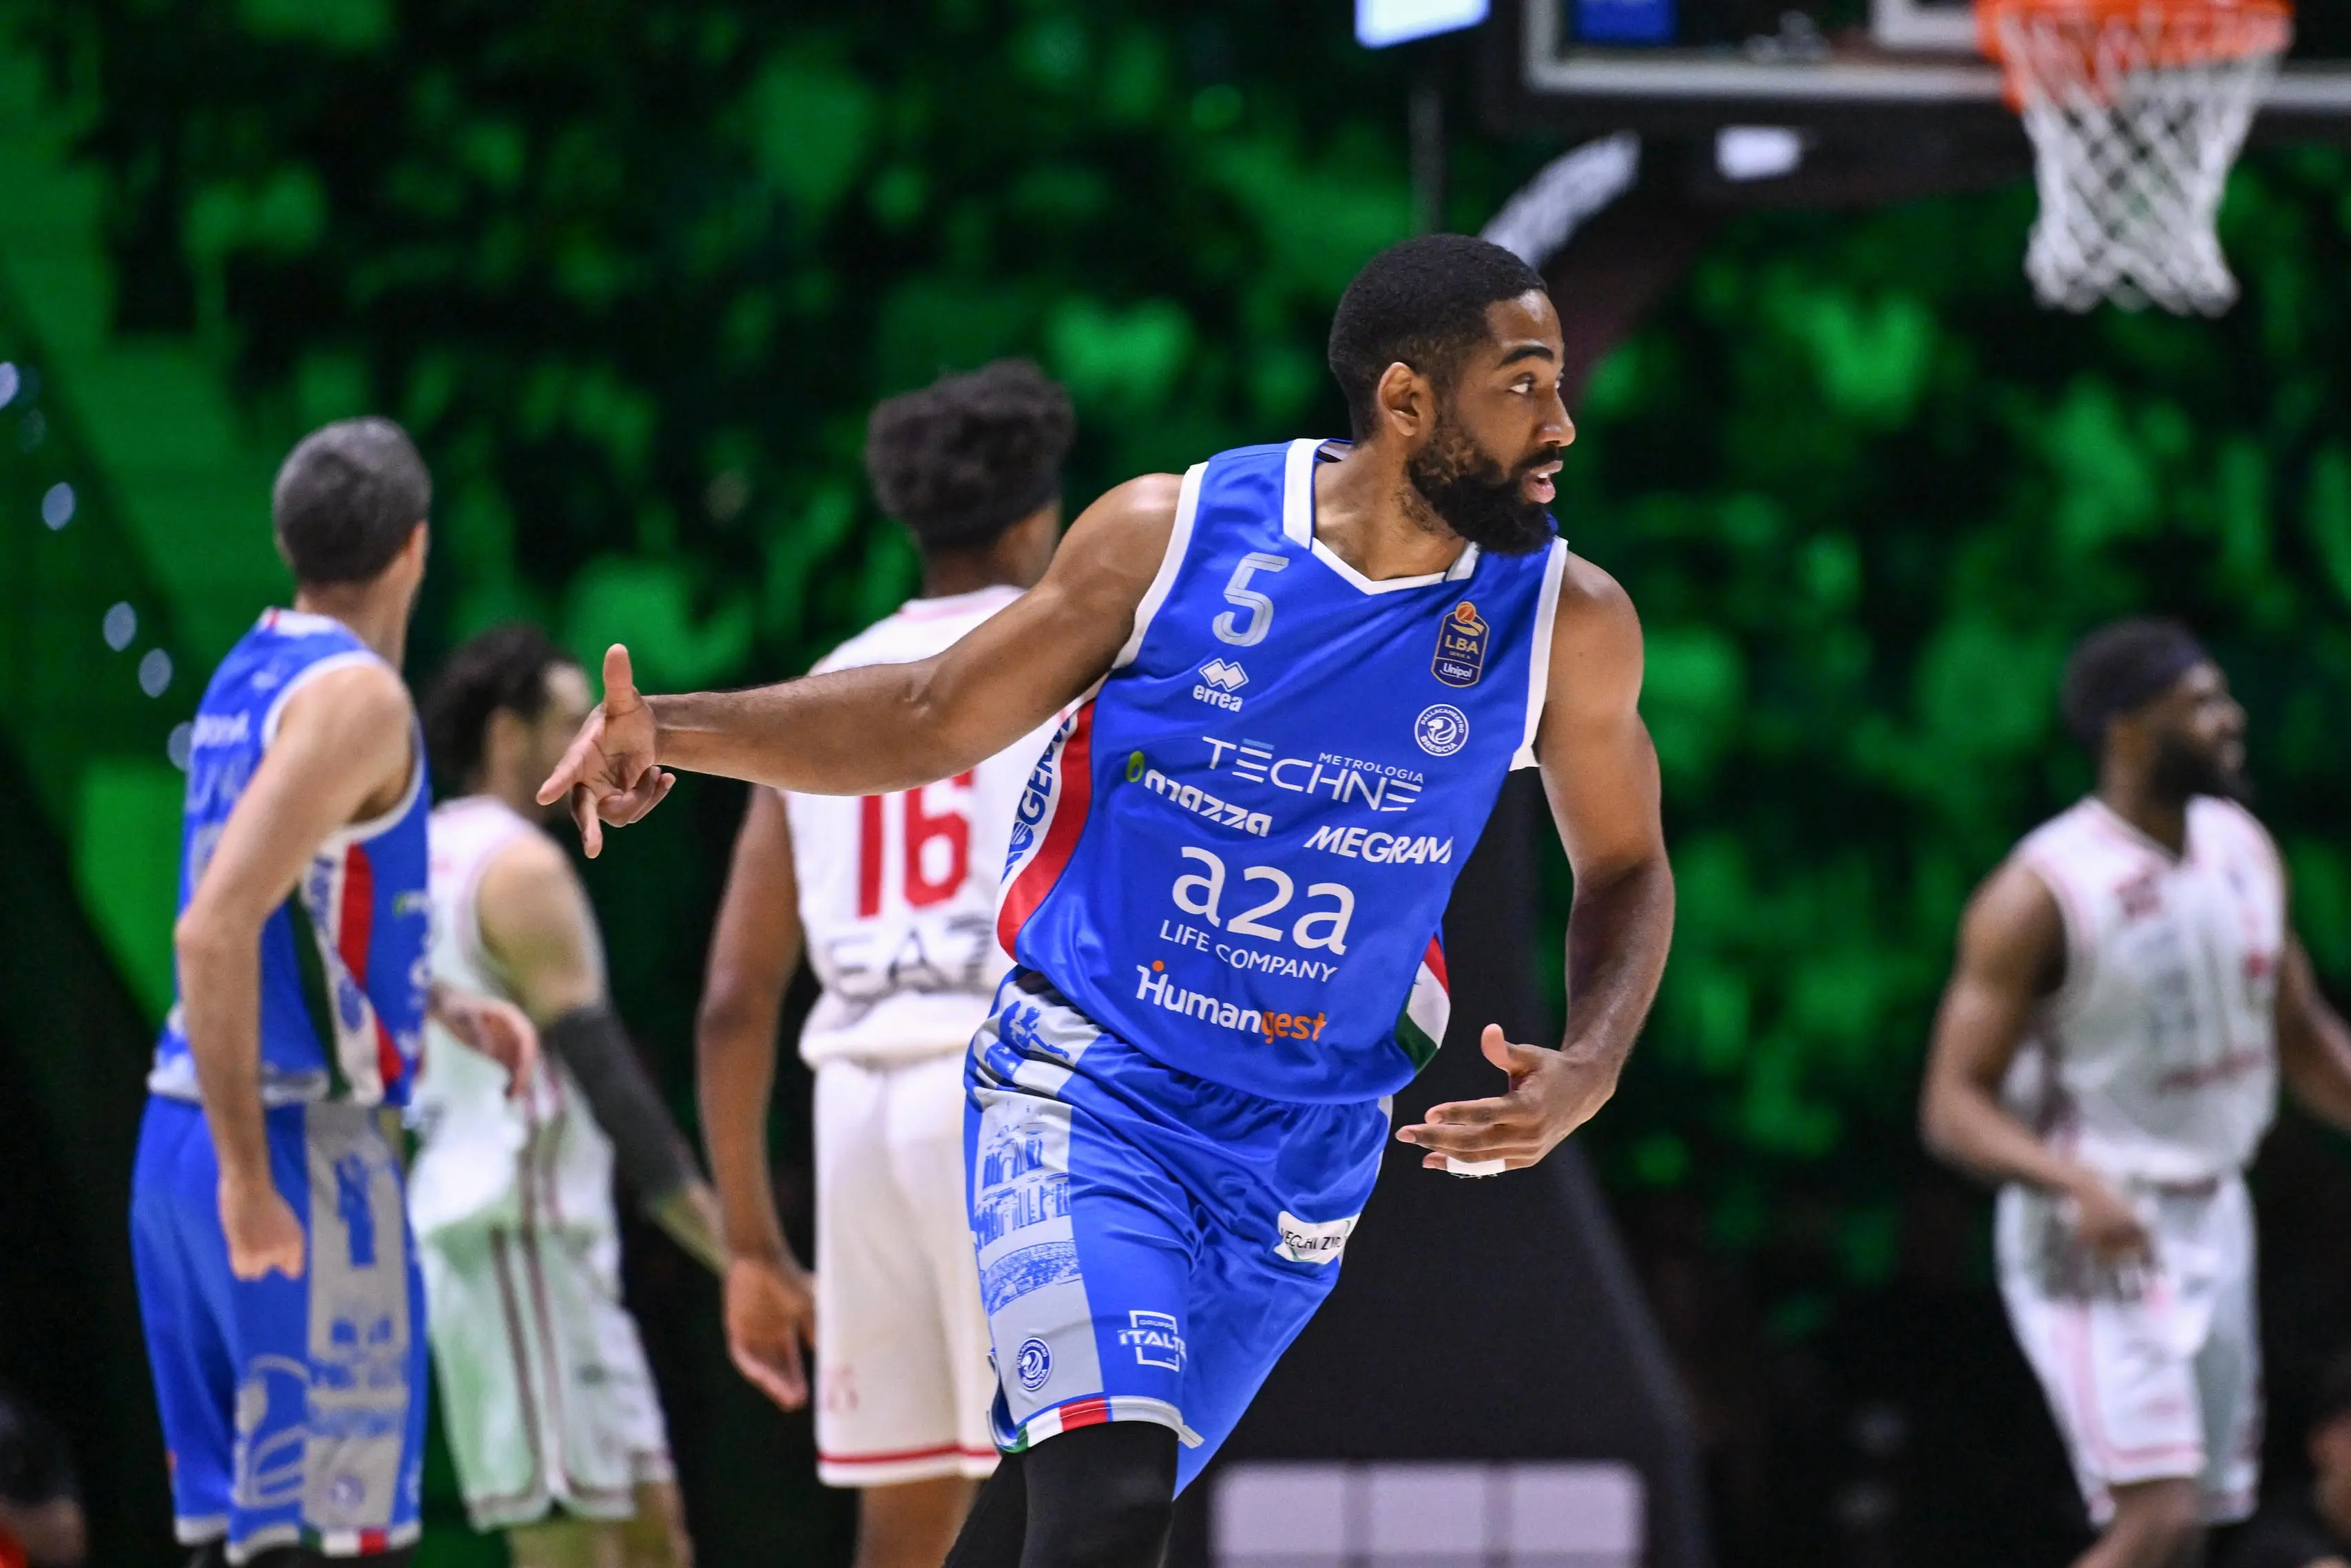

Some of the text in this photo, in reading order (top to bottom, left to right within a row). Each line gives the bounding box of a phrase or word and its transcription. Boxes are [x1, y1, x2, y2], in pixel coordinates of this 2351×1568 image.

[1212, 552, 1290, 647] 5
[1443, 662, 1472, 679] Unipol
[1444, 635, 1479, 655] LBA
[1202, 736, 1423, 812] TECHNE
[1318, 752, 1424, 784] METROLOGIA
[1420, 735, 1458, 753] BRESCIA
[1144, 769, 1273, 837] mazza
[856, 769, 973, 923] 16
[1303, 826, 1453, 864] MEGRAM
[1171, 846, 1355, 956] a2a
[1159, 919, 1339, 983] LIFE COMPANY
[1136, 960, 1327, 1044] Humangest
